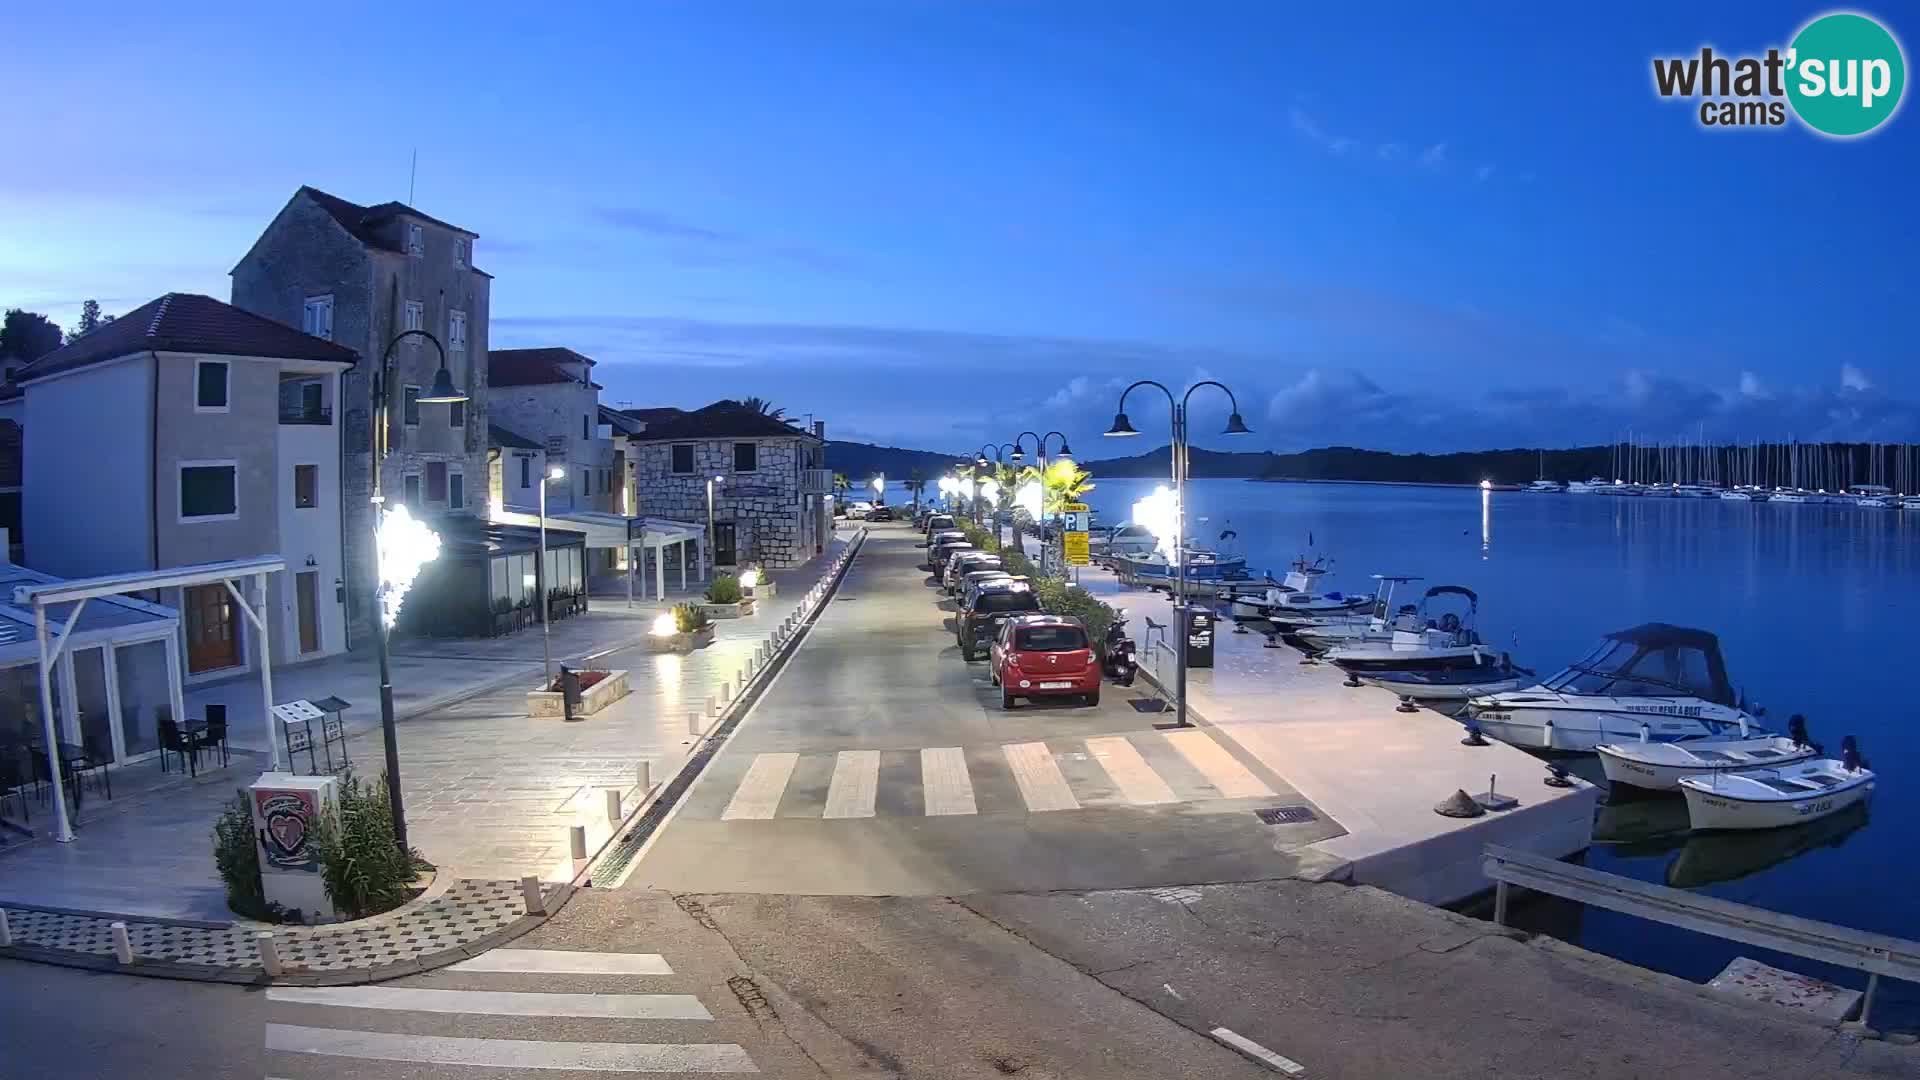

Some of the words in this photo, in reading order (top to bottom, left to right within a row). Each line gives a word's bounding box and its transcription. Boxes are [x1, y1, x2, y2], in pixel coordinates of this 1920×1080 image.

[1065, 514, 1076, 530] P
[1658, 705, 1677, 714] RENT
[1684, 706, 1702, 717] BOAT
